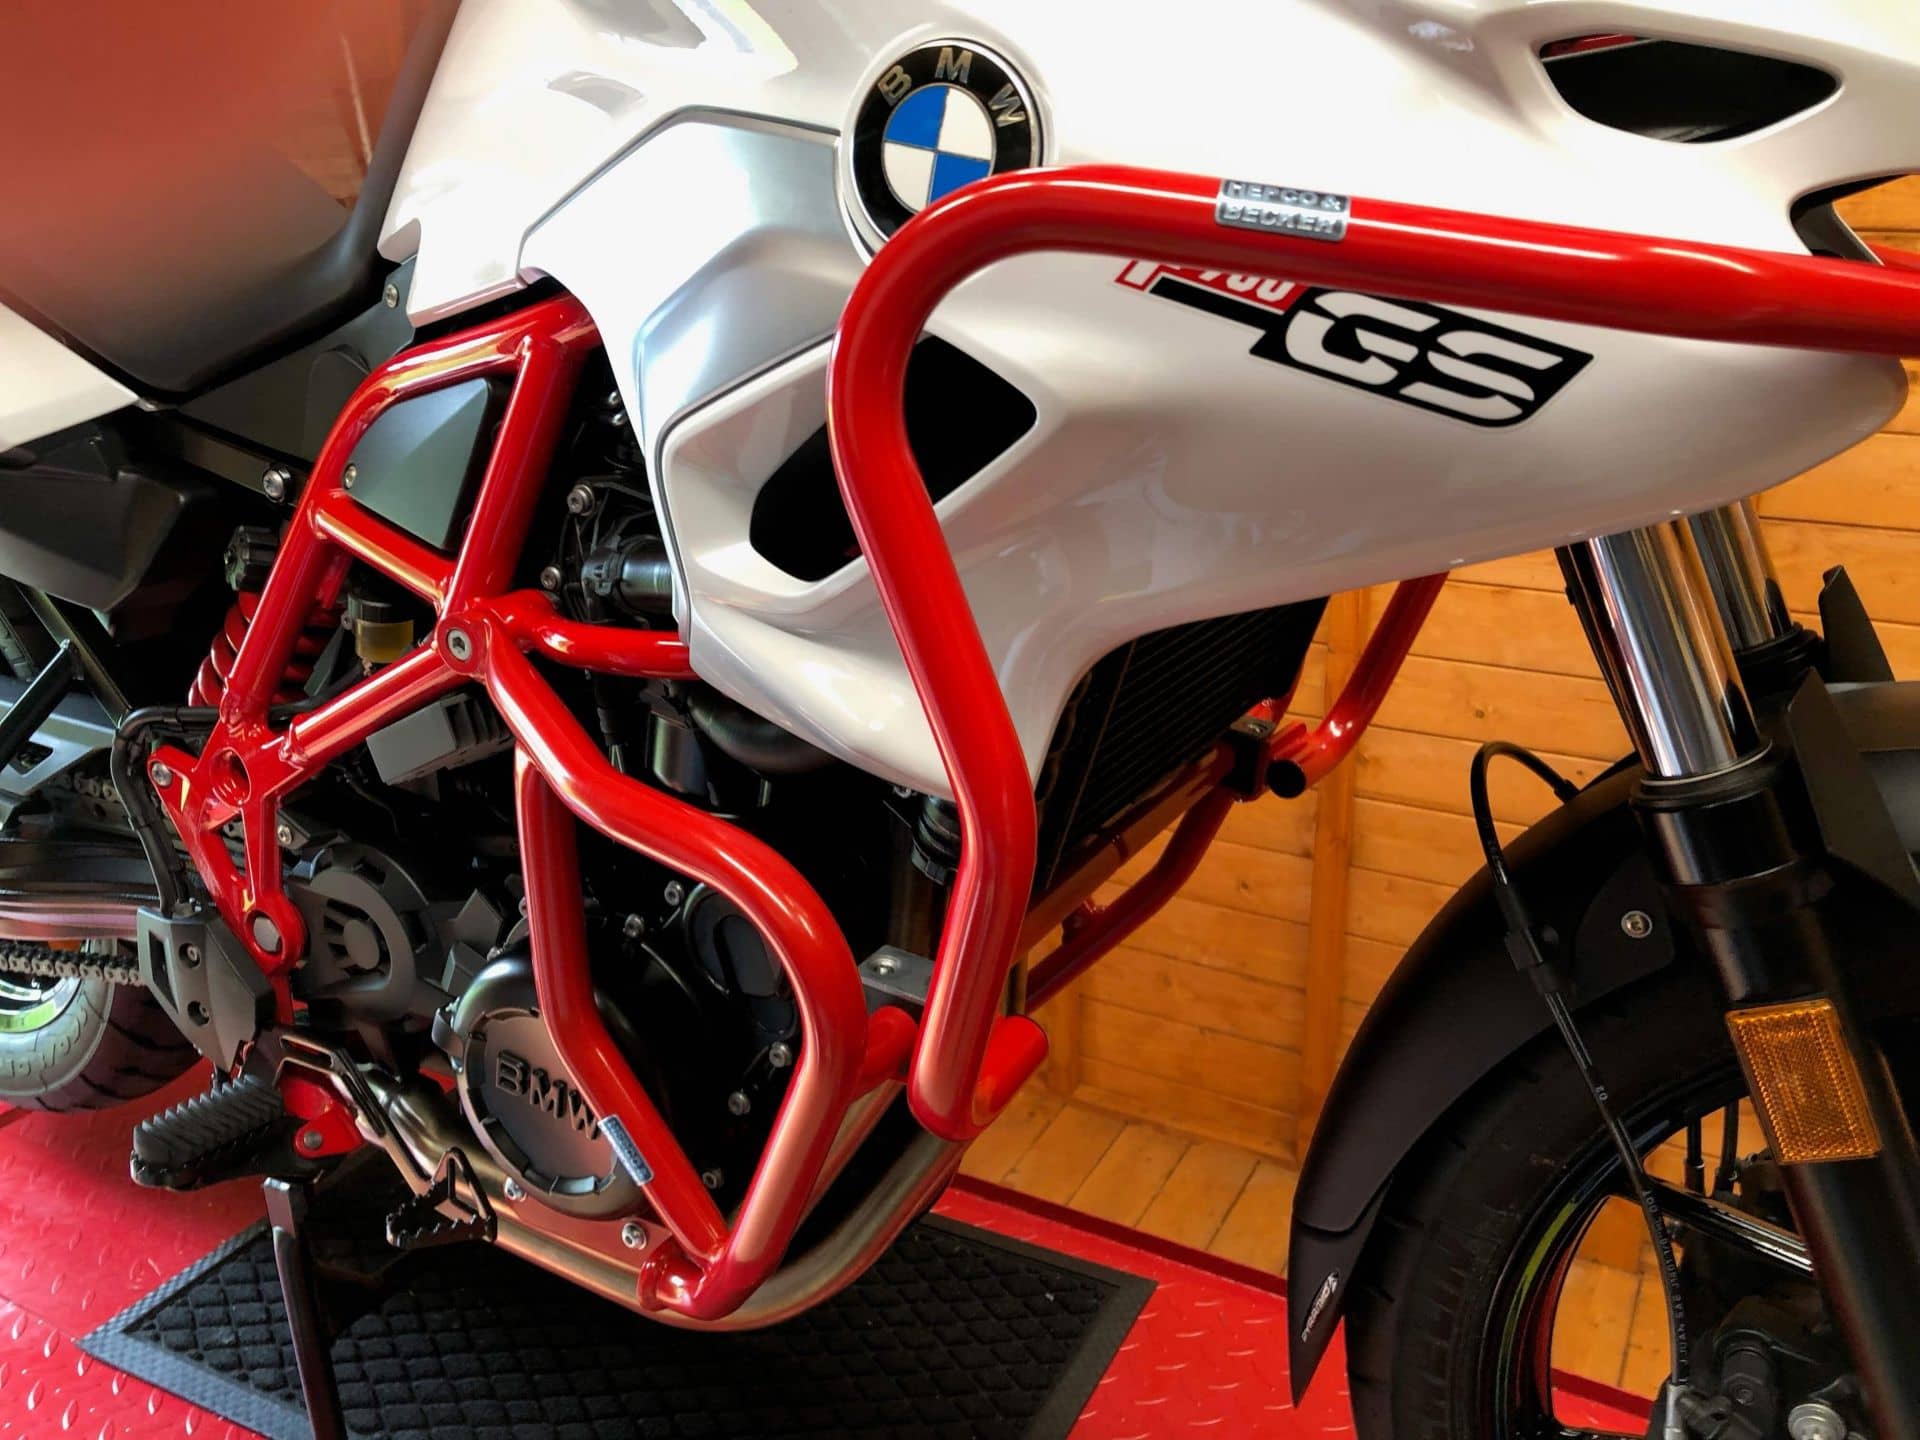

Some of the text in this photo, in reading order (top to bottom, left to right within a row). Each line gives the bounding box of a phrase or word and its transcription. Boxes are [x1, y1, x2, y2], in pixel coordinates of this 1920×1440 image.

[877, 46, 1027, 128] BMW
[1285, 290, 1564, 421] GS
[495, 1050, 603, 1142] BMW
